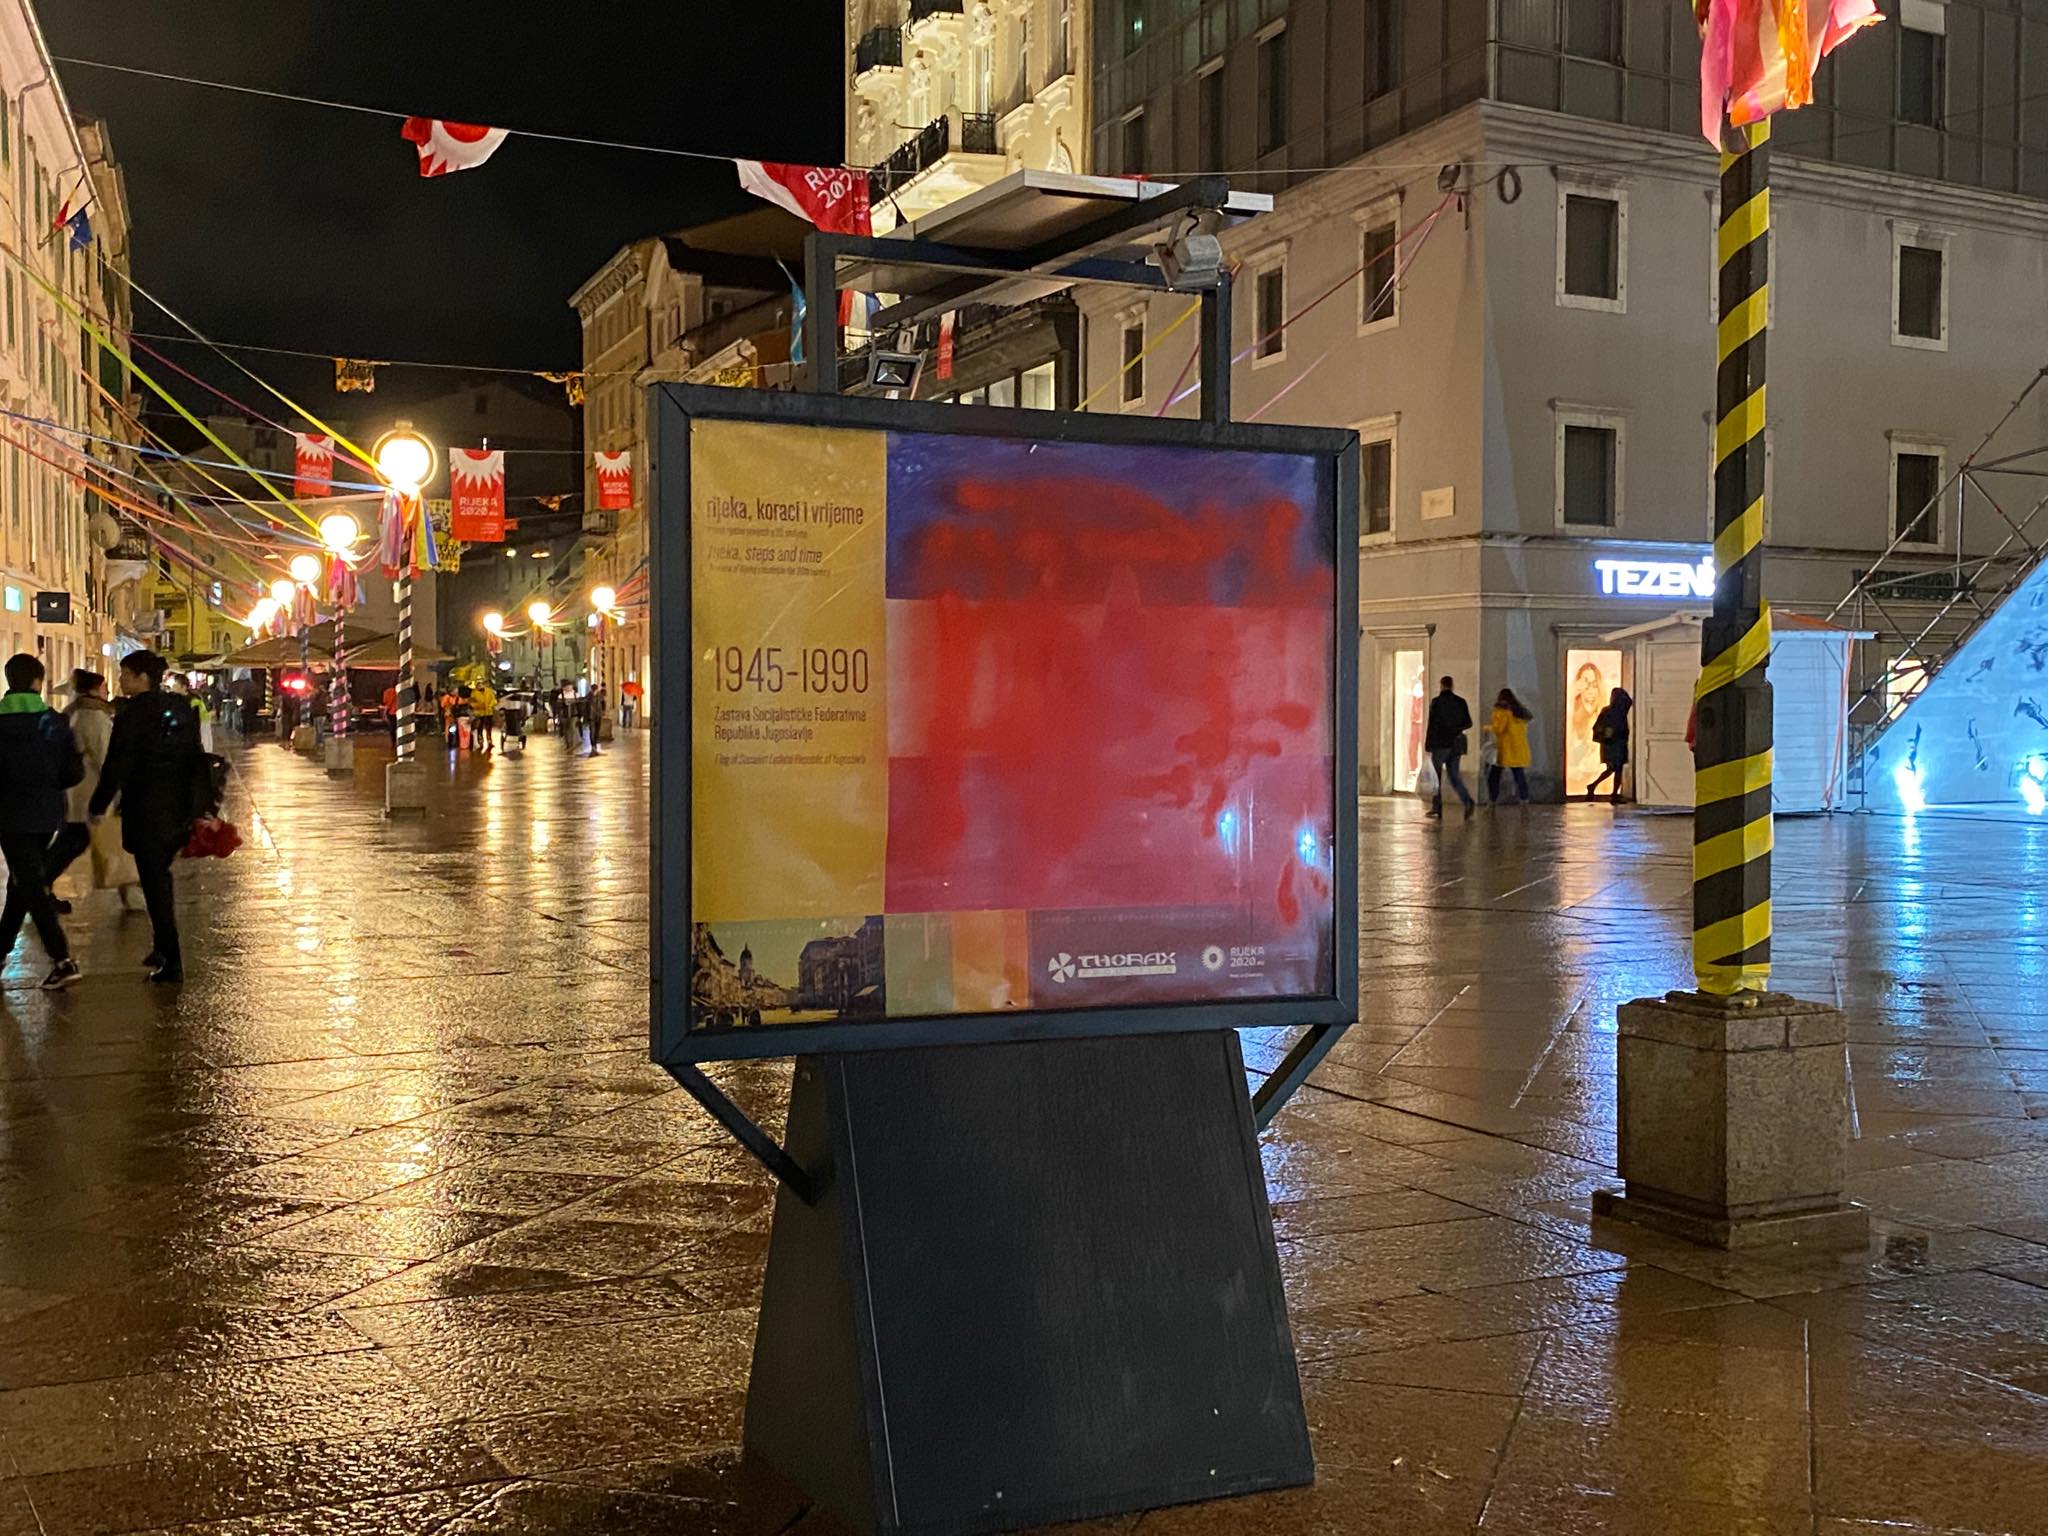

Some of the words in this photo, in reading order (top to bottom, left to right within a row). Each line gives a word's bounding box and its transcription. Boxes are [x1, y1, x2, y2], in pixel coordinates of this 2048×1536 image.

[817, 172, 852, 208] 202
[459, 497, 498, 507] RIJEKA
[756, 498, 800, 521] koraci
[804, 502, 808, 523] i
[811, 503, 864, 528] vrijeme
[745, 546, 775, 564] steps
[777, 546, 798, 562] and
[799, 549, 823, 563] time
[1594, 556, 1716, 597] TEZENI
[715, 646, 869, 693] 1945-1990
[714, 706, 750, 721] Zastava
[714, 725, 760, 742] Republike
[1230, 946, 1265, 957] RIJEKA
